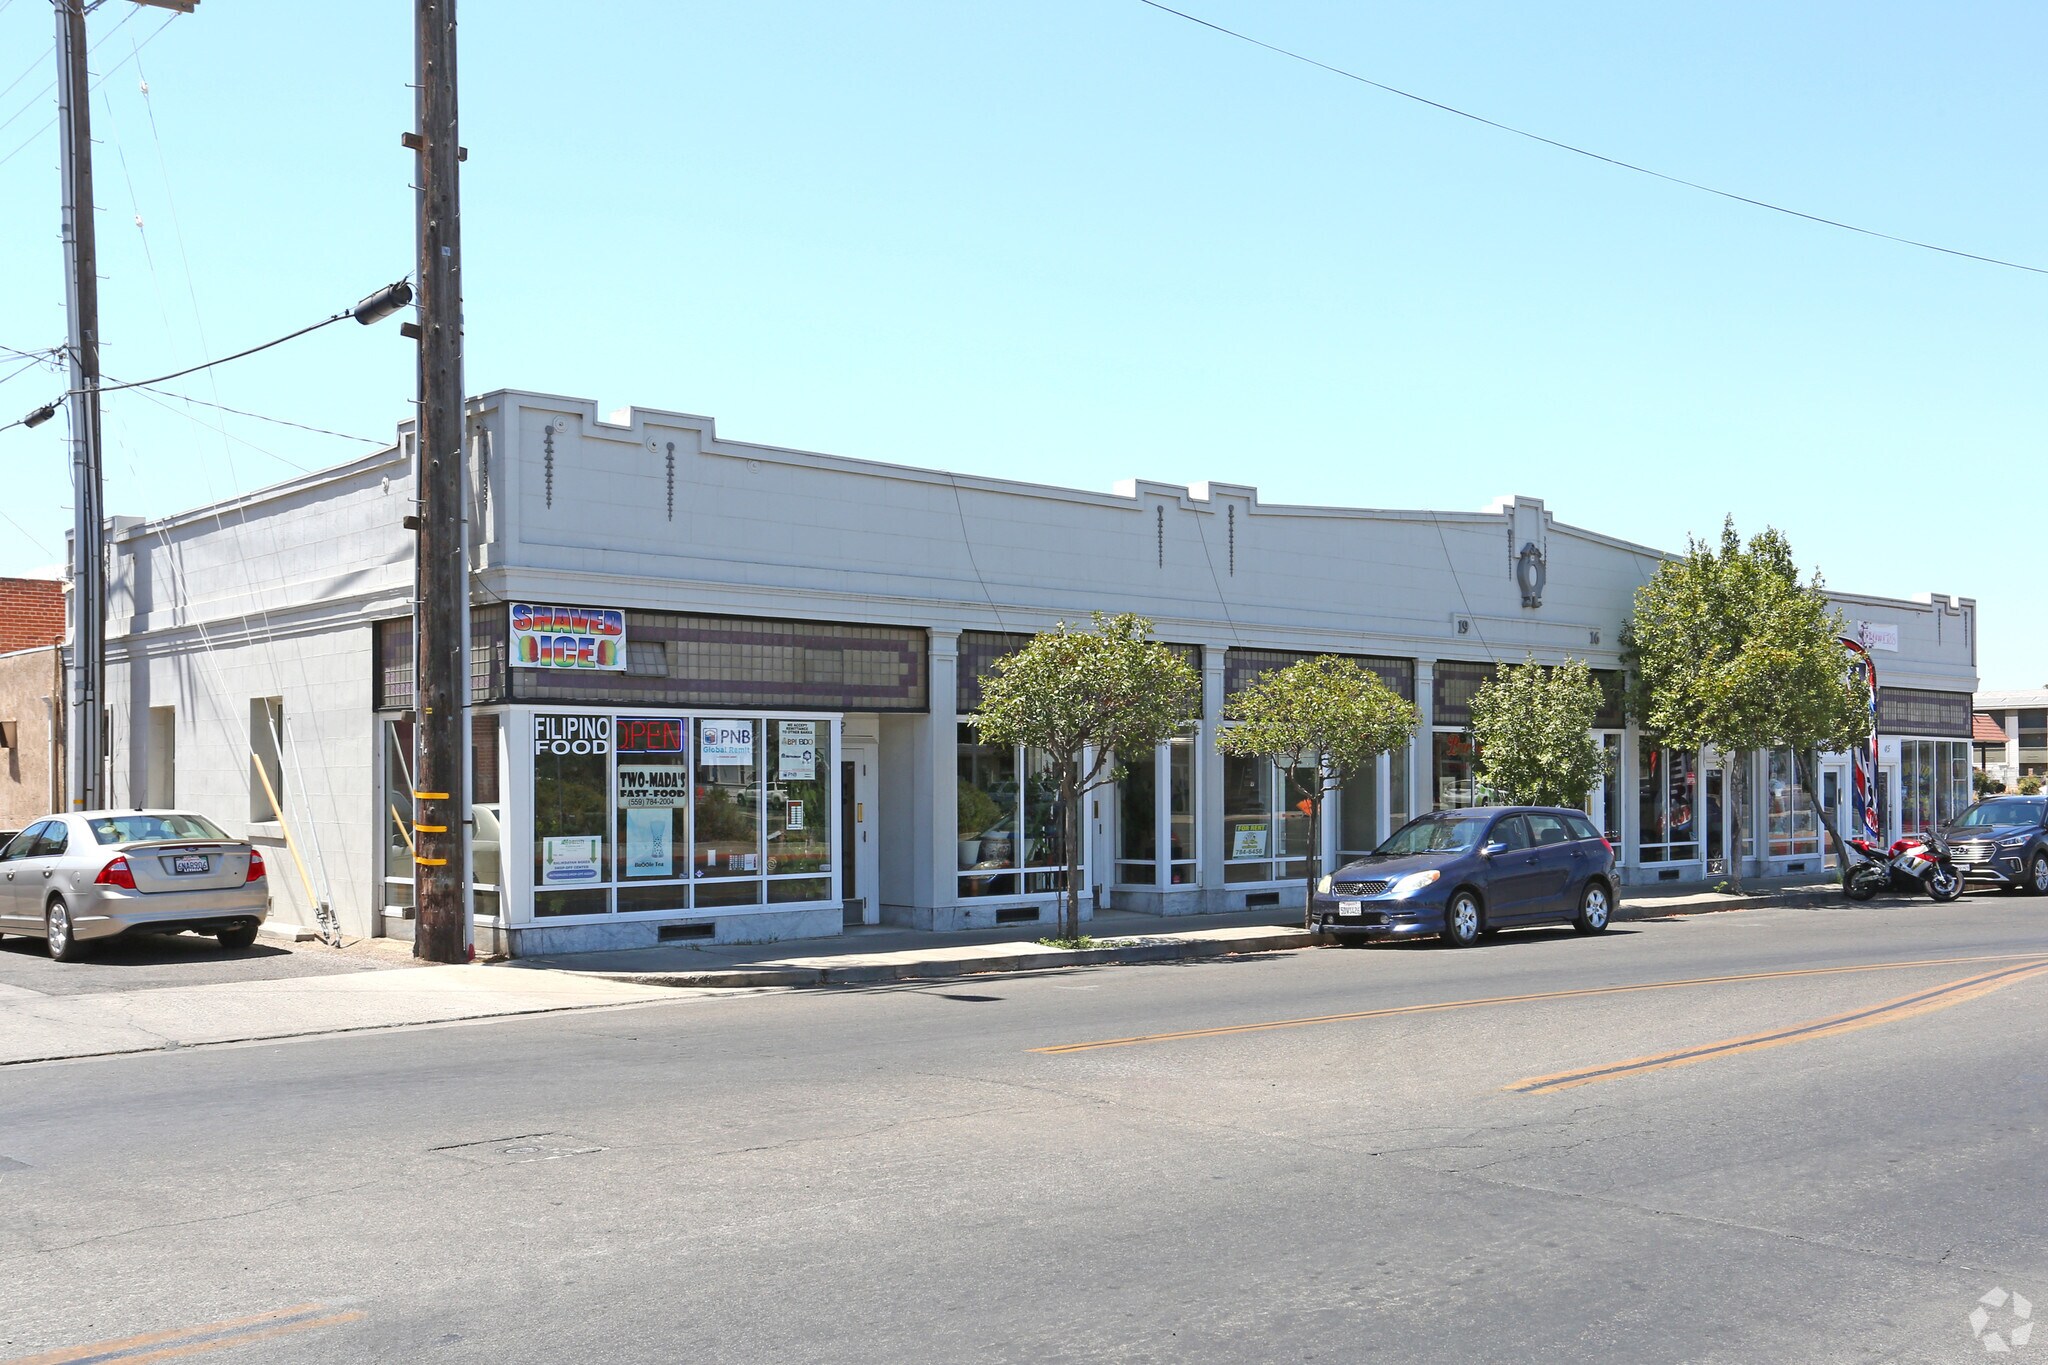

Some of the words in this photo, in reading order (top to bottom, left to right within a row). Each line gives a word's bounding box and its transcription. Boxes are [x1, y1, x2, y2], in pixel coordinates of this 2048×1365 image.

[512, 604, 622, 635] SHAVED
[540, 635, 595, 668] ICE
[535, 717, 610, 740] FILIPINO
[721, 729, 750, 744] PNB
[535, 740, 609, 755] FOOD
[619, 771, 686, 788] TWO-MADA'S
[620, 789, 685, 798] FAST-FOOD
[628, 798, 644, 806] (559)
